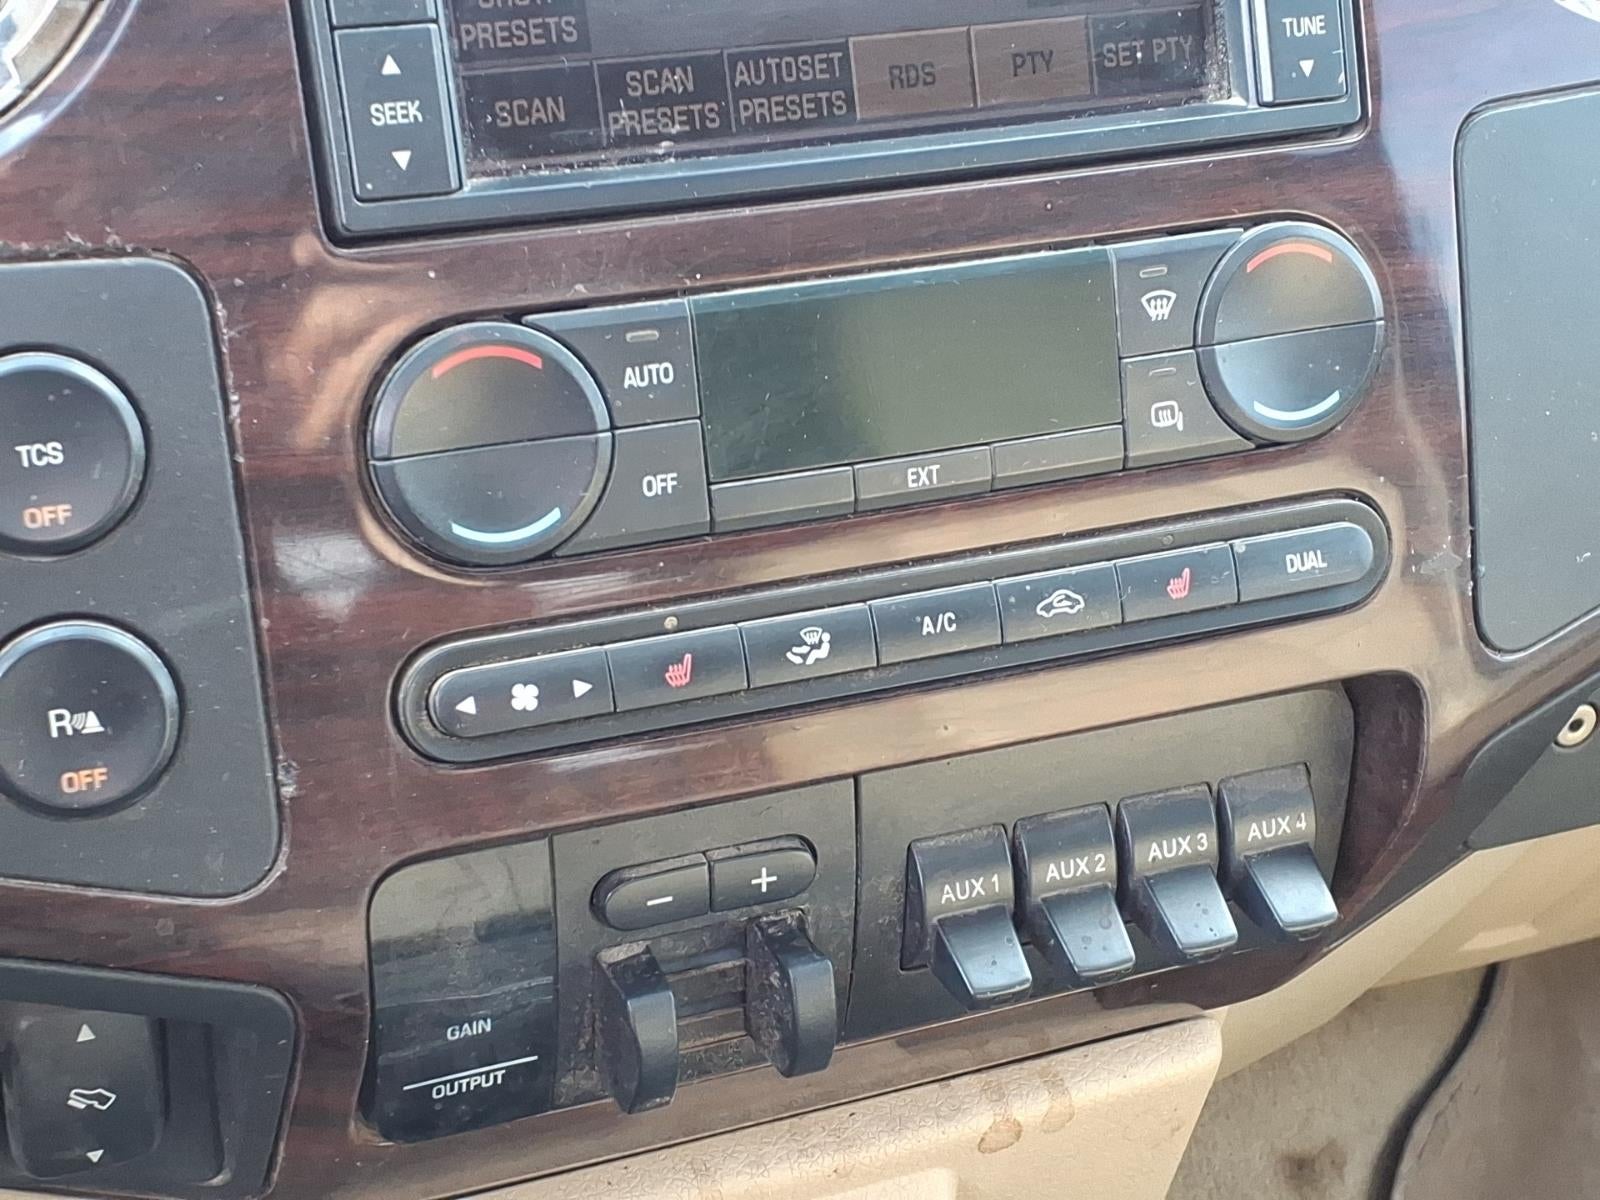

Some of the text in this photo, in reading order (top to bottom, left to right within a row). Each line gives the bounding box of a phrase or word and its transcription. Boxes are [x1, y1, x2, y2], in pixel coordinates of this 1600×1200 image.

[460, 16, 578, 51] PRESETS
[1282, 14, 1327, 38] TUNE
[1011, 50, 1054, 78] PTY
[1103, 34, 1193, 69] SET PTY
[625, 66, 694, 98] SCAN
[734, 52, 844, 89] AUTOSET
[888, 62, 936, 91] RDS
[369, 101, 424, 126] SEEK
[493, 96, 567, 128] SCAN
[608, 101, 720, 138] PRESETS
[740, 90, 848, 125] PRESETS
[624, 361, 674, 389] AUTO
[15, 442, 64, 468] TCS
[642, 472, 678, 498] OFF
[907, 464, 941, 489] EXT
[22, 504, 73, 529] OFF
[1286, 549, 1328, 574] DUAL
[921, 611, 957, 637] A/C
[61, 767, 108, 794] OFF
[1247, 812, 1307, 842] AUX 4
[1148, 832, 1208, 862] AUX 3
[1045, 853, 1107, 883] AUX 2
[940, 873, 1000, 904] AUX 1
[446, 1018, 492, 1042] GAIN
[432, 1069, 506, 1100] OUTPUT
